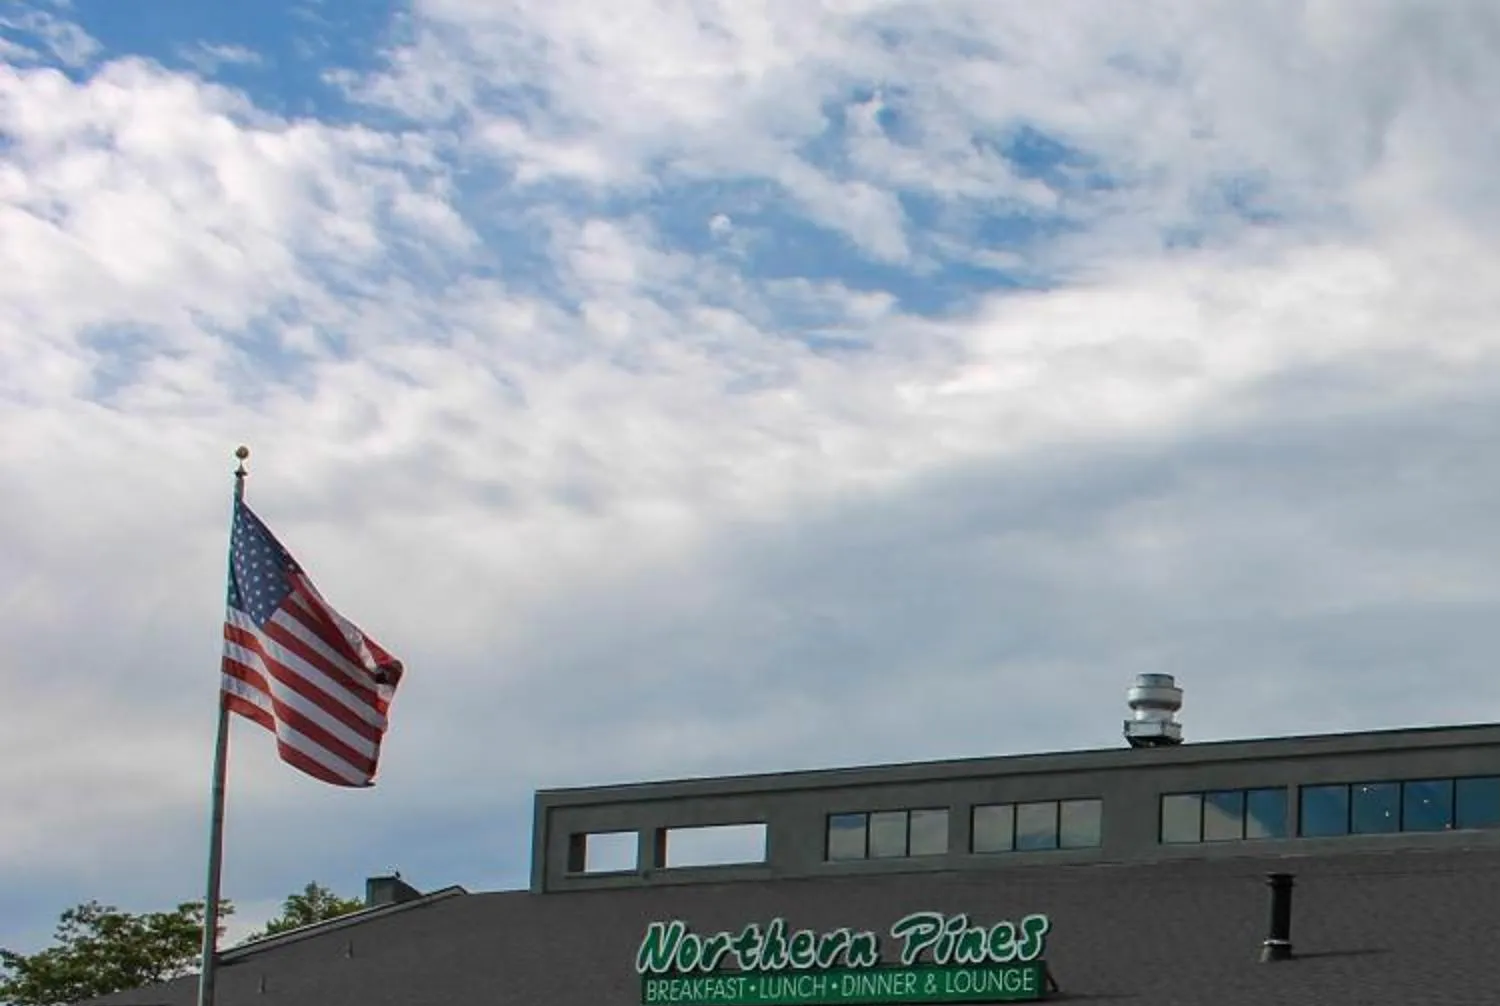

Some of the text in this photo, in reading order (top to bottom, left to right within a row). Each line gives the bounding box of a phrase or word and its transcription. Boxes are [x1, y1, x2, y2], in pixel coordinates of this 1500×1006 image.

[636, 911, 1049, 974] Northern Pines
[646, 968, 1035, 1001] BREAKFAST LUNCH DINNER & LOUNGE
